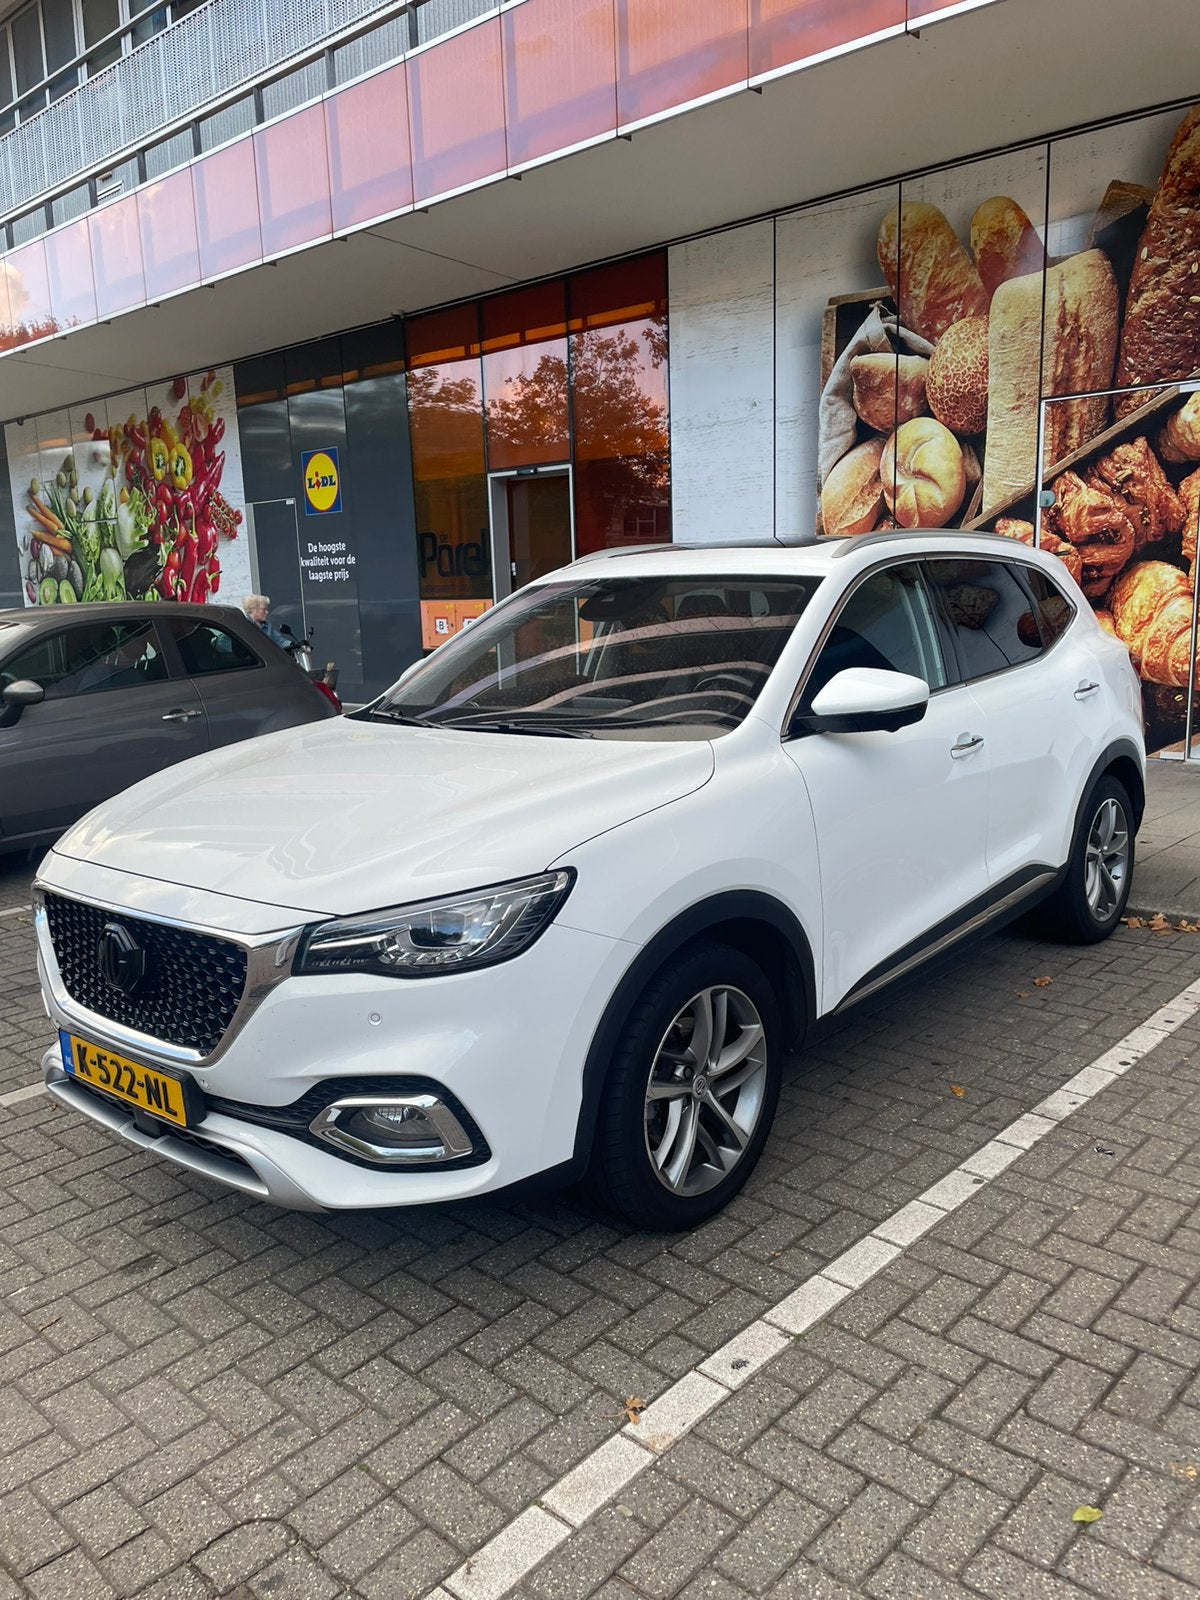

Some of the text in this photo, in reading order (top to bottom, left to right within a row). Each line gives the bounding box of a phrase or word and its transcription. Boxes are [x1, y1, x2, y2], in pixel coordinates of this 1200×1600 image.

[307, 541, 346, 554] De hoogste
[418, 528, 489, 578] Parel
[300, 553, 356, 567] kwaliteit voor de
[308, 568, 350, 582] laagste prijs
[65, 1056, 74, 1067] NL
[76, 1043, 178, 1117] K-522-NL
